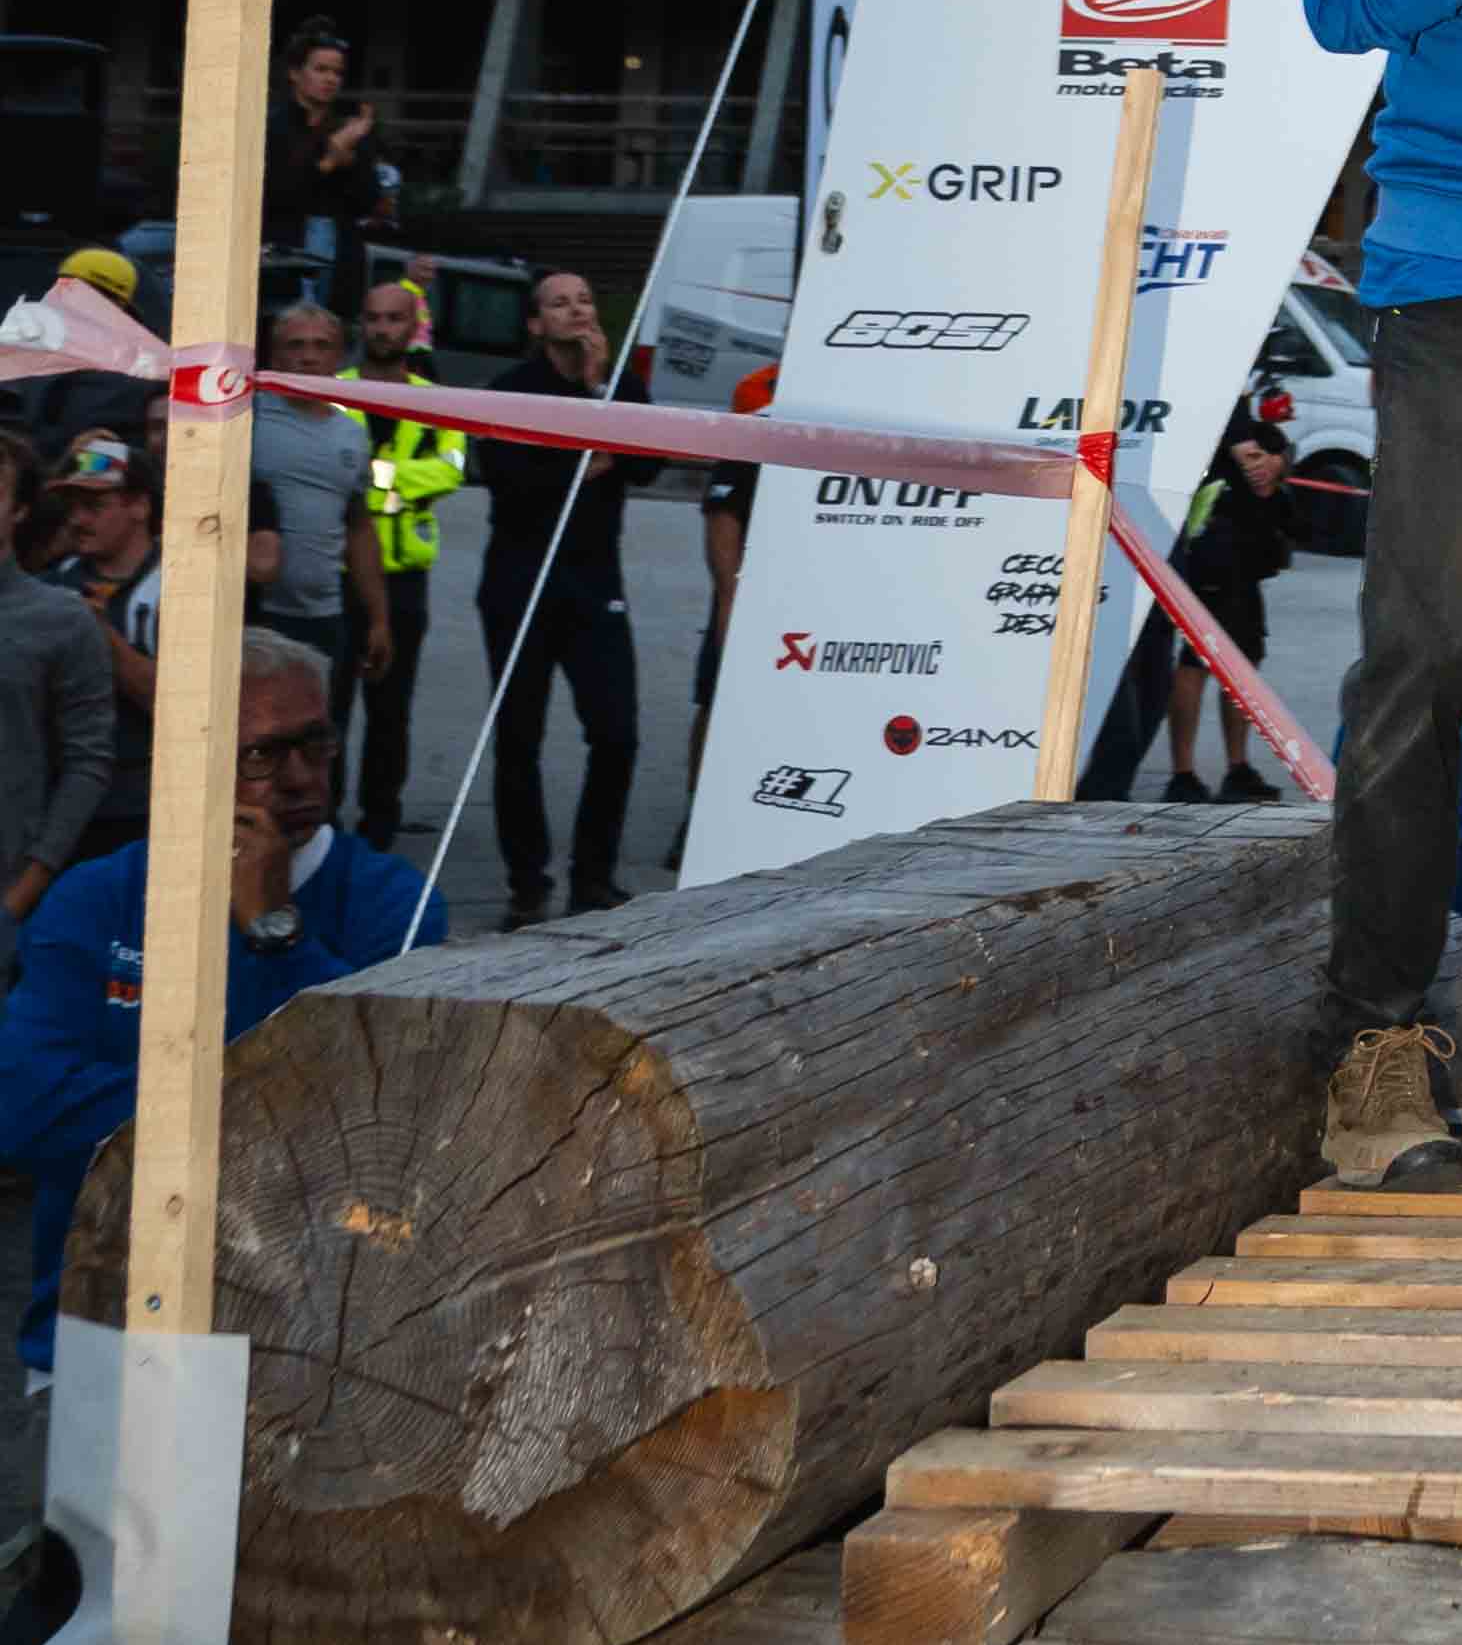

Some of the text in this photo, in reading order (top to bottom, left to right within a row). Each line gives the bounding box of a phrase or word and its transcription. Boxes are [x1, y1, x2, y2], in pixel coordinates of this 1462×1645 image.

[1017, 396, 1172, 433] LAOR
[816, 474, 884, 507] ON
[815, 514, 985, 528] SWITCH ON RIDE OFF
[1001, 553, 1064, 576] CECC
[925, 726, 1041, 750] 24MX
